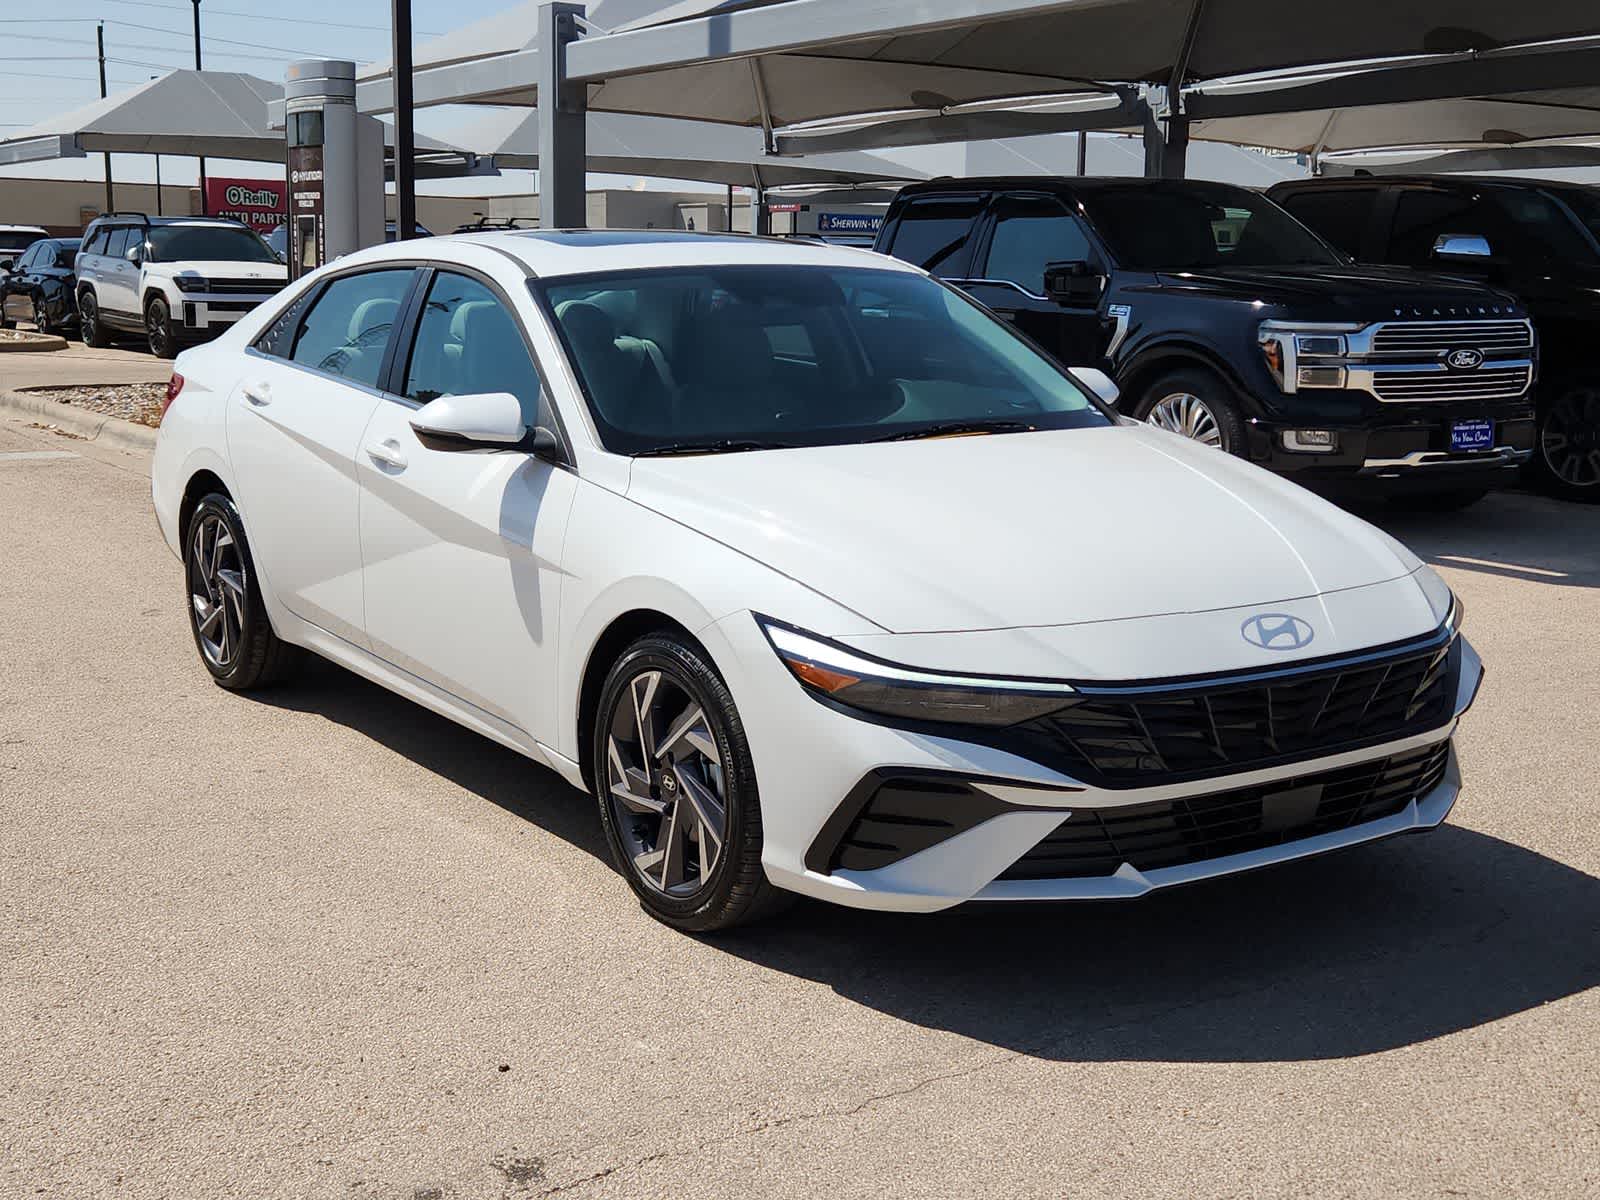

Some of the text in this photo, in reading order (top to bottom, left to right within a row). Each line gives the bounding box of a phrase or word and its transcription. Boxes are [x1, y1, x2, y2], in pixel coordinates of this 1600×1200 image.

[226, 186, 278, 208] O'Reilly
[252, 212, 288, 225] PARTS
[1454, 352, 1476, 365] Ford
